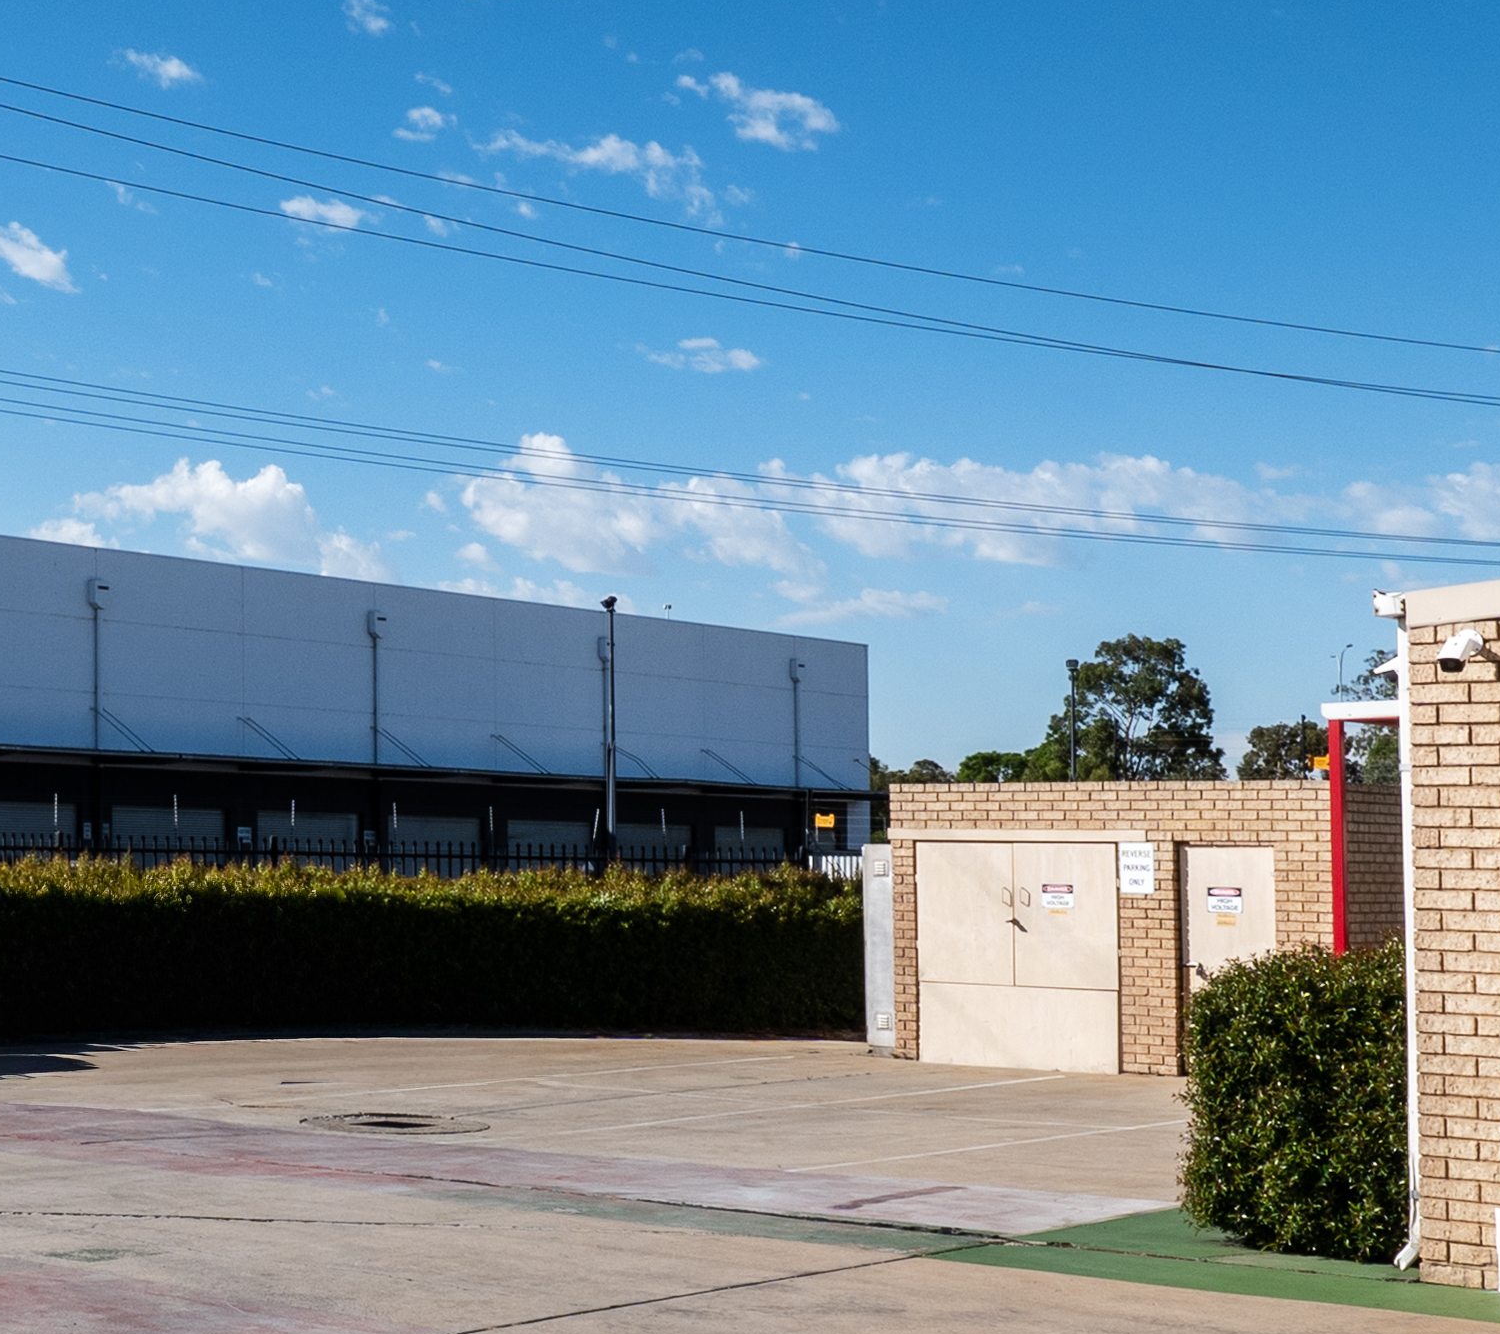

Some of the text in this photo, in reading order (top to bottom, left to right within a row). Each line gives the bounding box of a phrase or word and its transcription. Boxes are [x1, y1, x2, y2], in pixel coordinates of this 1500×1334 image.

[1121, 850, 1151, 858] REVERSE
[1123, 863, 1151, 872] PARKING
[1128, 878, 1145, 886] ONLY
